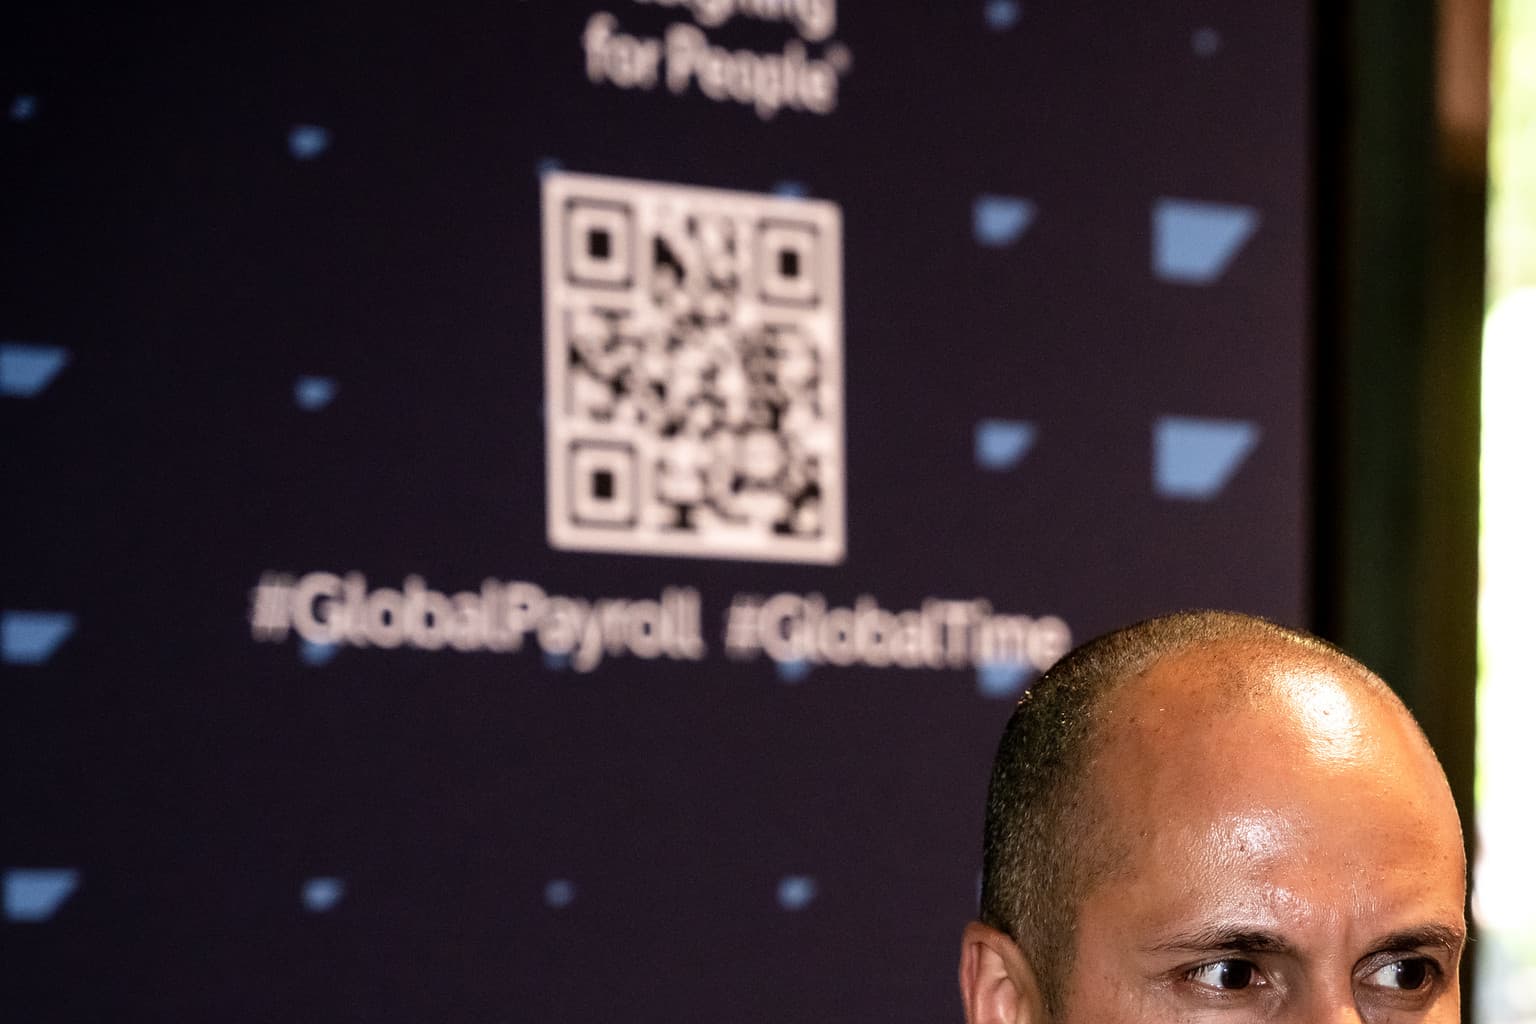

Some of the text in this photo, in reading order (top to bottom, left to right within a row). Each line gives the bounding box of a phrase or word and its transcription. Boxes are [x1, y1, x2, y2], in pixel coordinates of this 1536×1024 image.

[585, 12, 659, 88] for
[251, 570, 1071, 672] #GlobalPayroll #GlobalTime
